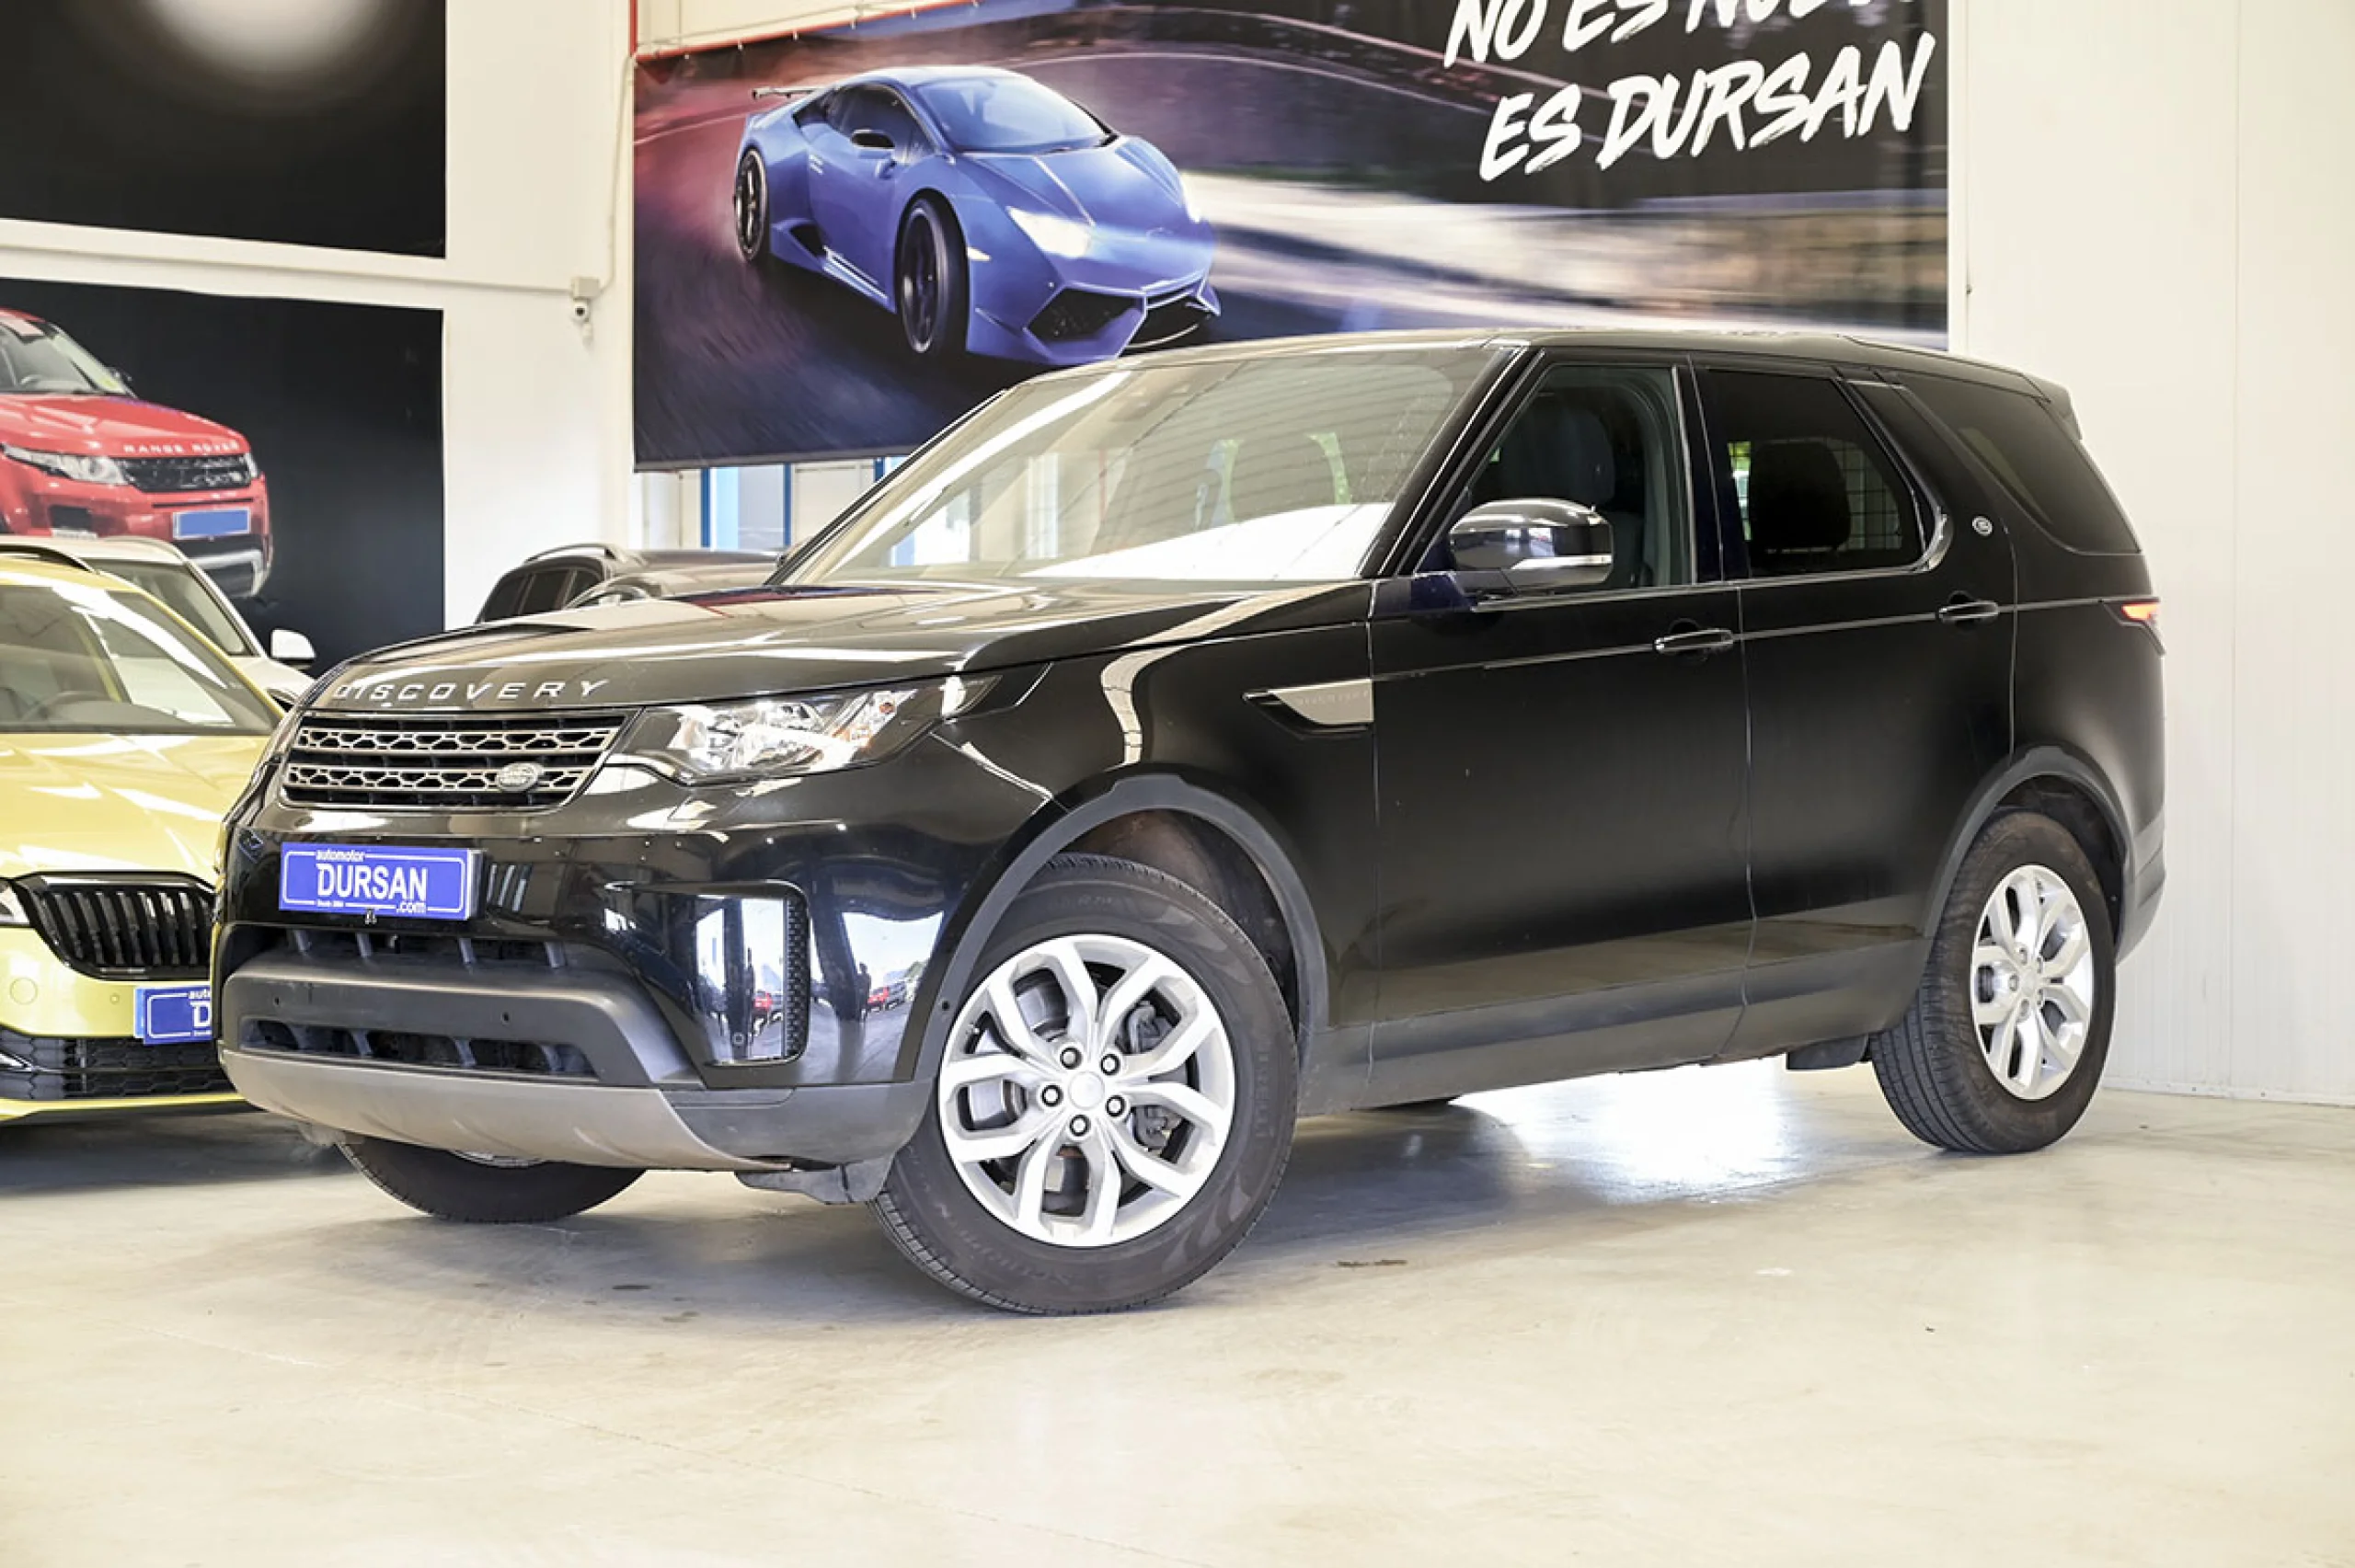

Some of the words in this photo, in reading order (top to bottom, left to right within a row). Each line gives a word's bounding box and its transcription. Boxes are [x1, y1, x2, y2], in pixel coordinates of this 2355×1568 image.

[1443, 0, 1547, 69] NO
[1479, 84, 1582, 182] ES
[1595, 31, 1936, 172] DURSAN
[333, 679, 610, 701] DISCOVERY
[316, 863, 428, 902] DURSAN
